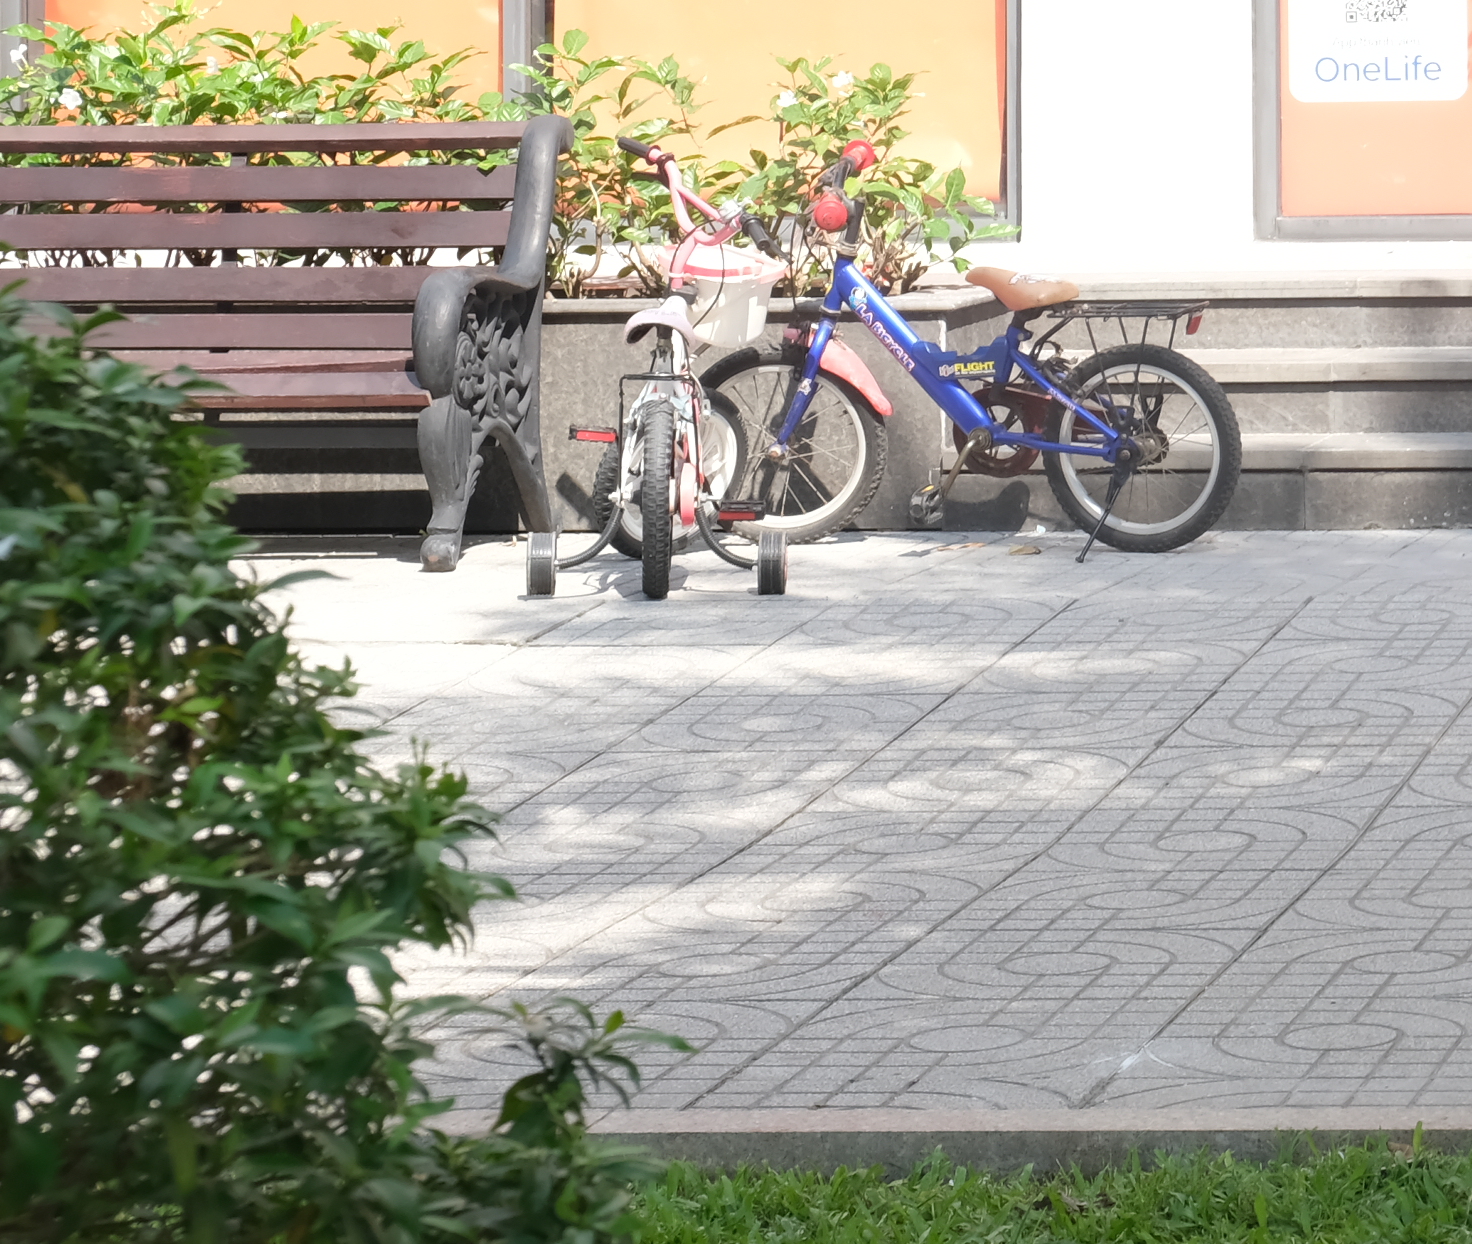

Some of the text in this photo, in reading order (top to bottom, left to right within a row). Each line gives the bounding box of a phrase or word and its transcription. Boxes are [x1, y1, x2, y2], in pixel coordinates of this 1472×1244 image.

[1315, 55, 1442, 82] OneLife
[855, 303, 916, 372] LA BICYCLE
[954, 361, 996, 371] FLIGHT
